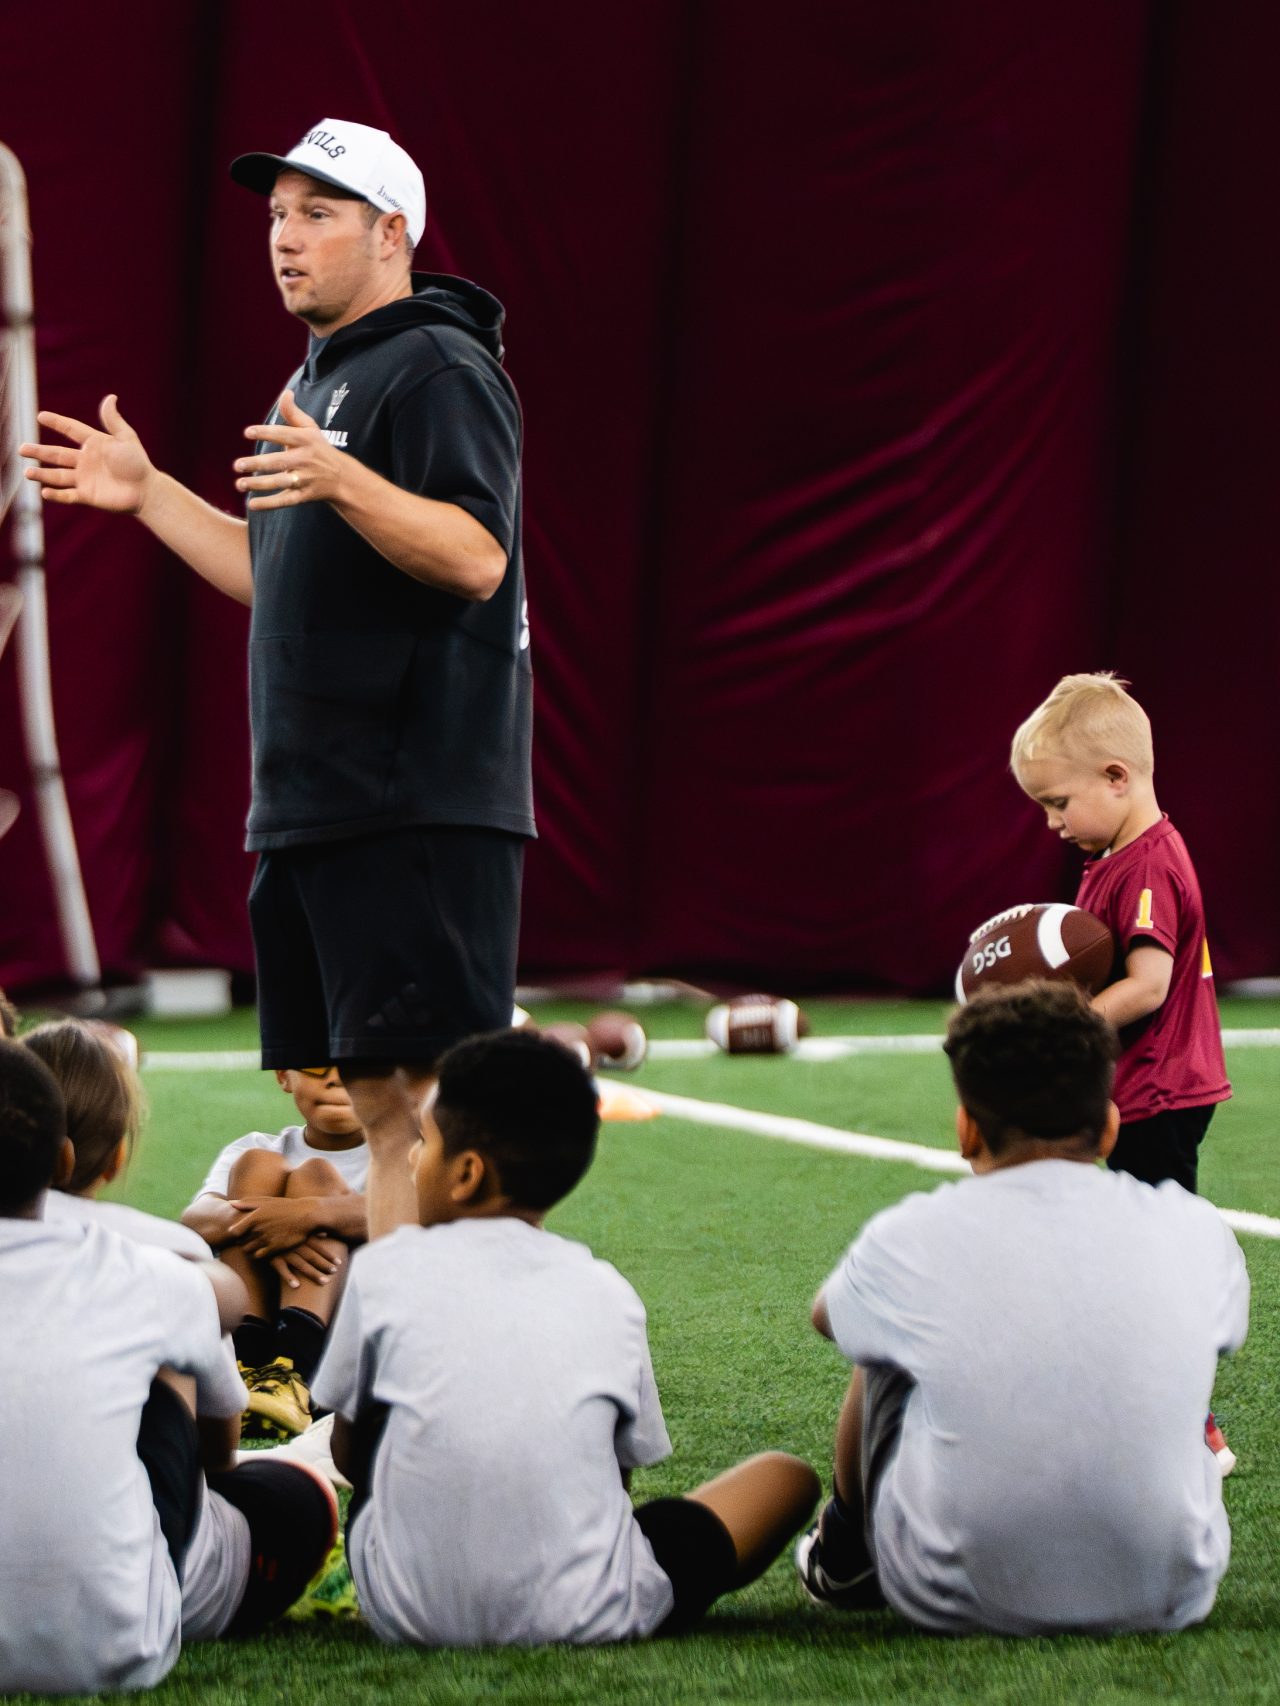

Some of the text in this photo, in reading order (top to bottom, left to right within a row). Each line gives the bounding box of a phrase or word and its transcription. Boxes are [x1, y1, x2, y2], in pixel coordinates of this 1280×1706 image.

[304, 130, 346, 159] VILS
[1135, 888, 1153, 928] 1
[973, 935, 1012, 975] DSG
